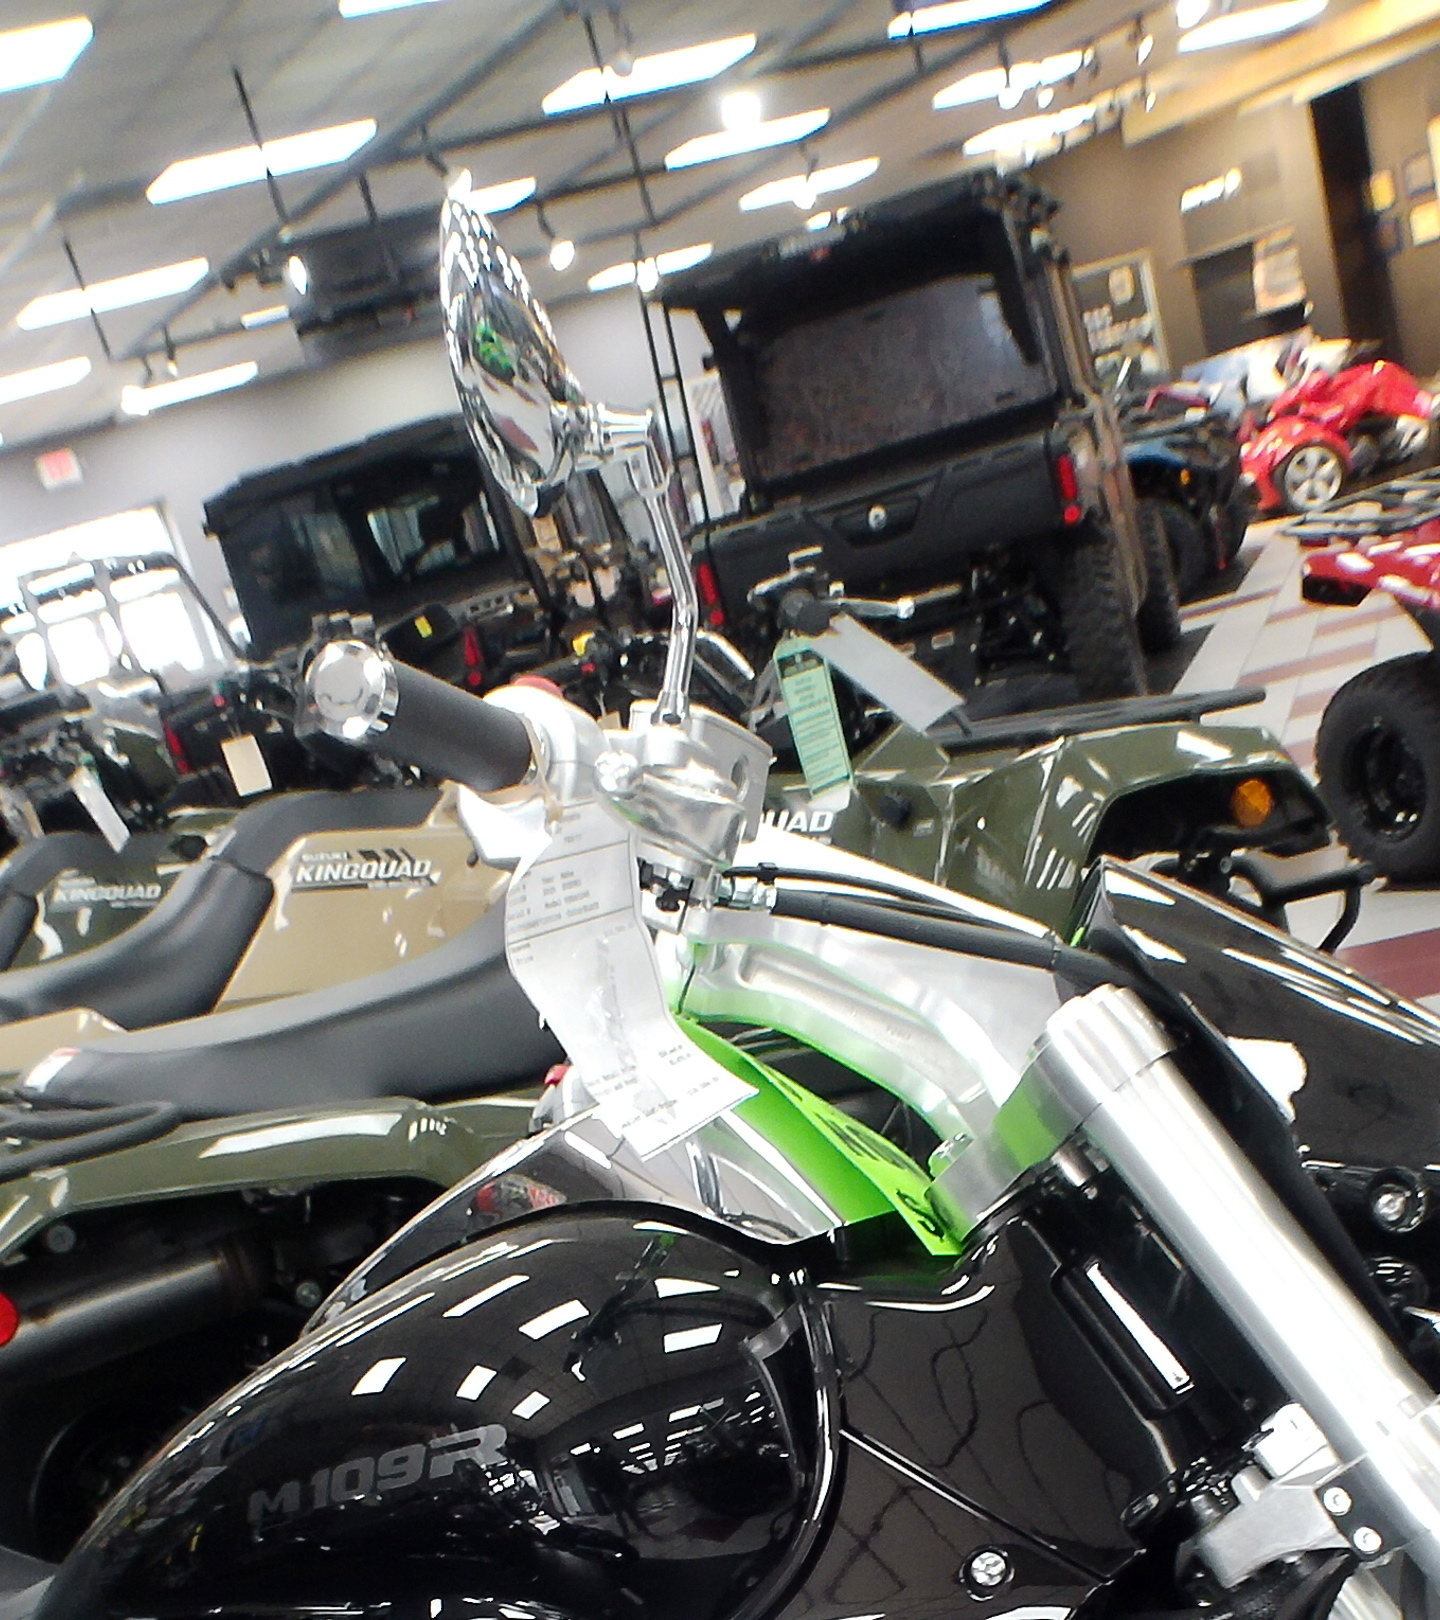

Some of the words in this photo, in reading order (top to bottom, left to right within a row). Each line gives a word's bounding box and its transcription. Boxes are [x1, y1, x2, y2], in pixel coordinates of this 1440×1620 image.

[759, 807, 835, 833] UAD
[301, 851, 348, 863] SUZUKI
[295, 859, 432, 883] KINGQUAD
[246, 1423, 508, 1523] M109R
